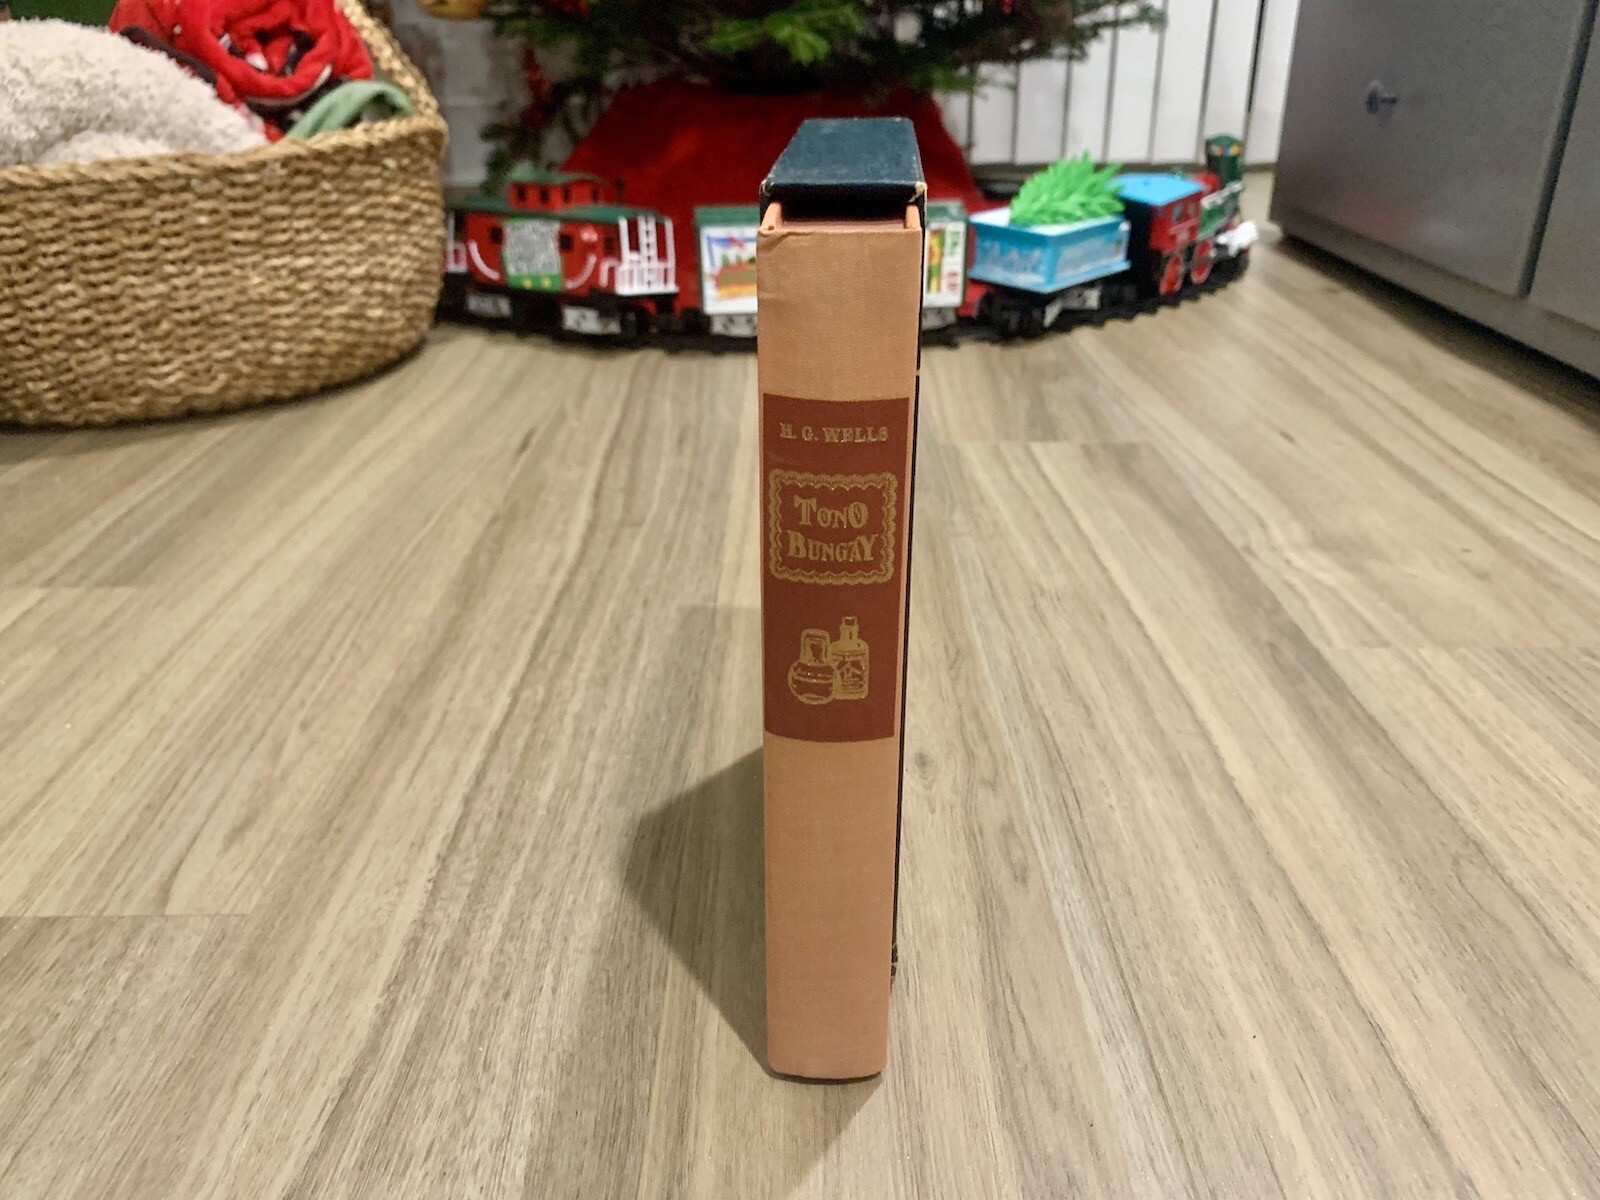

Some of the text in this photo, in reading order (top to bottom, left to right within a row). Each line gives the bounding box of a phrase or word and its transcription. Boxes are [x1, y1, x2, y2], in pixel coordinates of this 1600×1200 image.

[801, 425, 819, 441] G.
[822, 425, 889, 443] WELLS
[787, 529, 879, 562] BUNGAY
